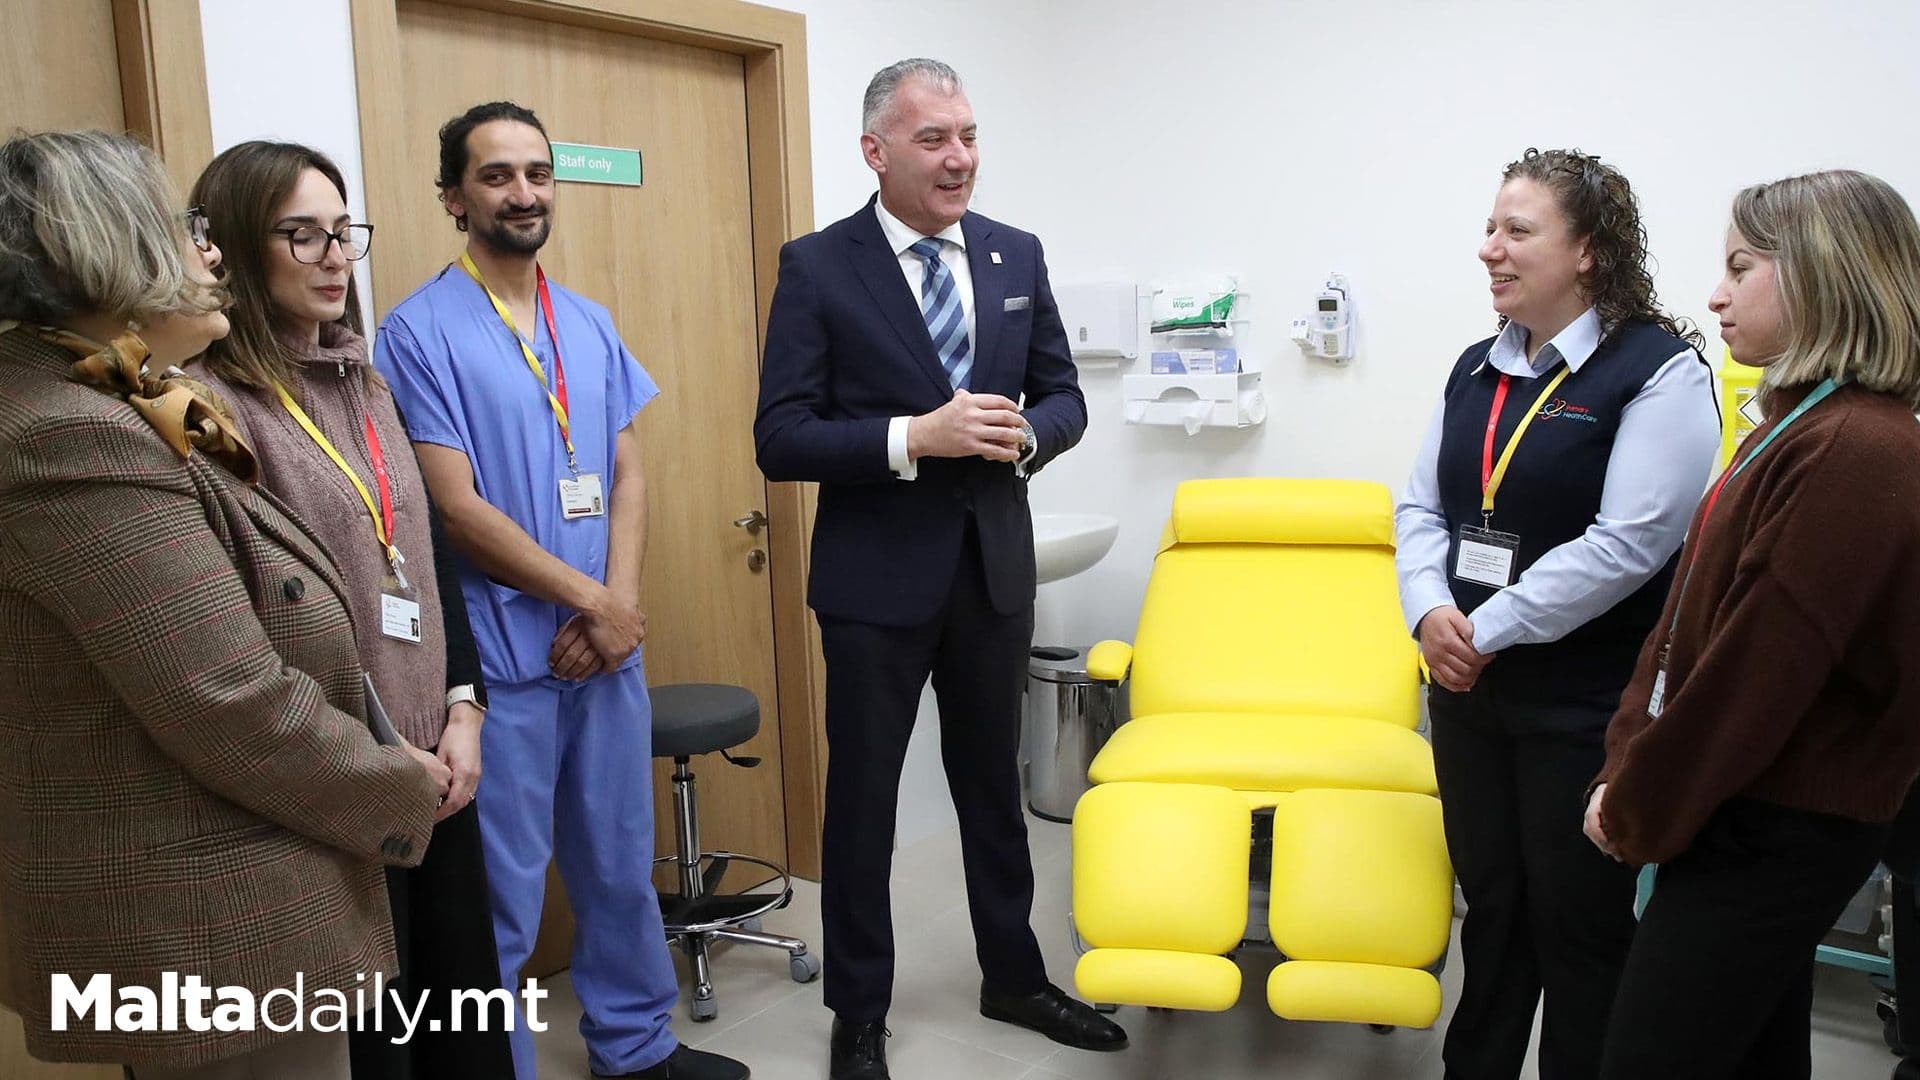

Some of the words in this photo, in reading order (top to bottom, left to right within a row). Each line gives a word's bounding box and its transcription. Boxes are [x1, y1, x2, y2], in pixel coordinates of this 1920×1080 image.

[559, 154, 585, 168] Staff
[588, 157, 612, 173] only
[1172, 300, 1195, 310] Wipes
